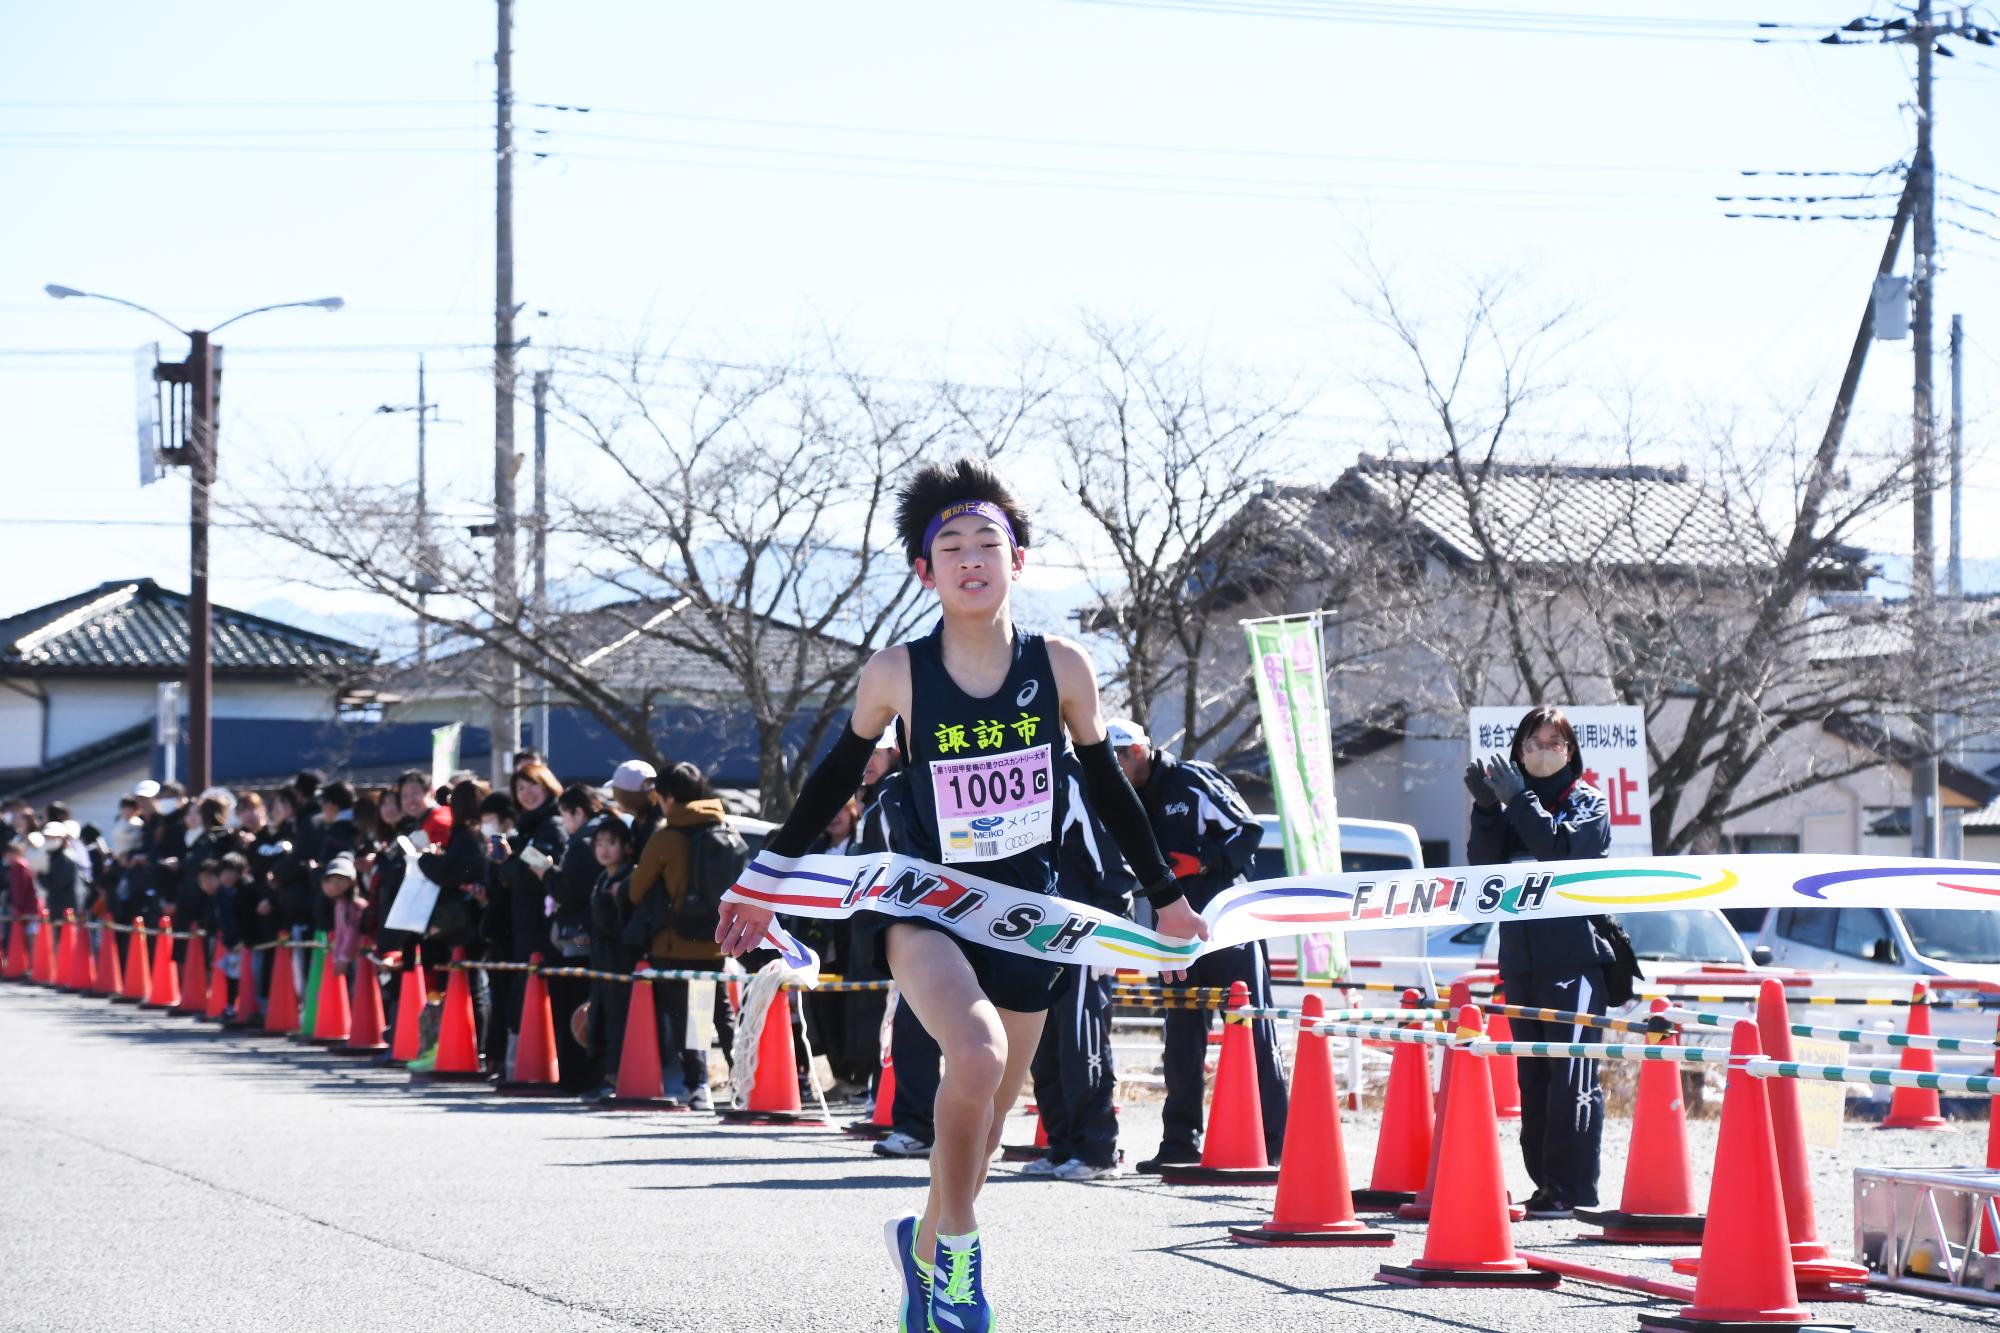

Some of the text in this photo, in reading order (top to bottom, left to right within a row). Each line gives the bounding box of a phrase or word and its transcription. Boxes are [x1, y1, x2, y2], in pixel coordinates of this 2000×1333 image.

[934, 712, 1041, 754] 諏訪市
[949, 767, 1046, 809] 1003 C
[973, 829, 1004, 840] MEIKO
[1008, 810, 1050, 830] メイコー
[840, 863, 1101, 953] FINISH
[1350, 872, 1555, 920] FINISH
